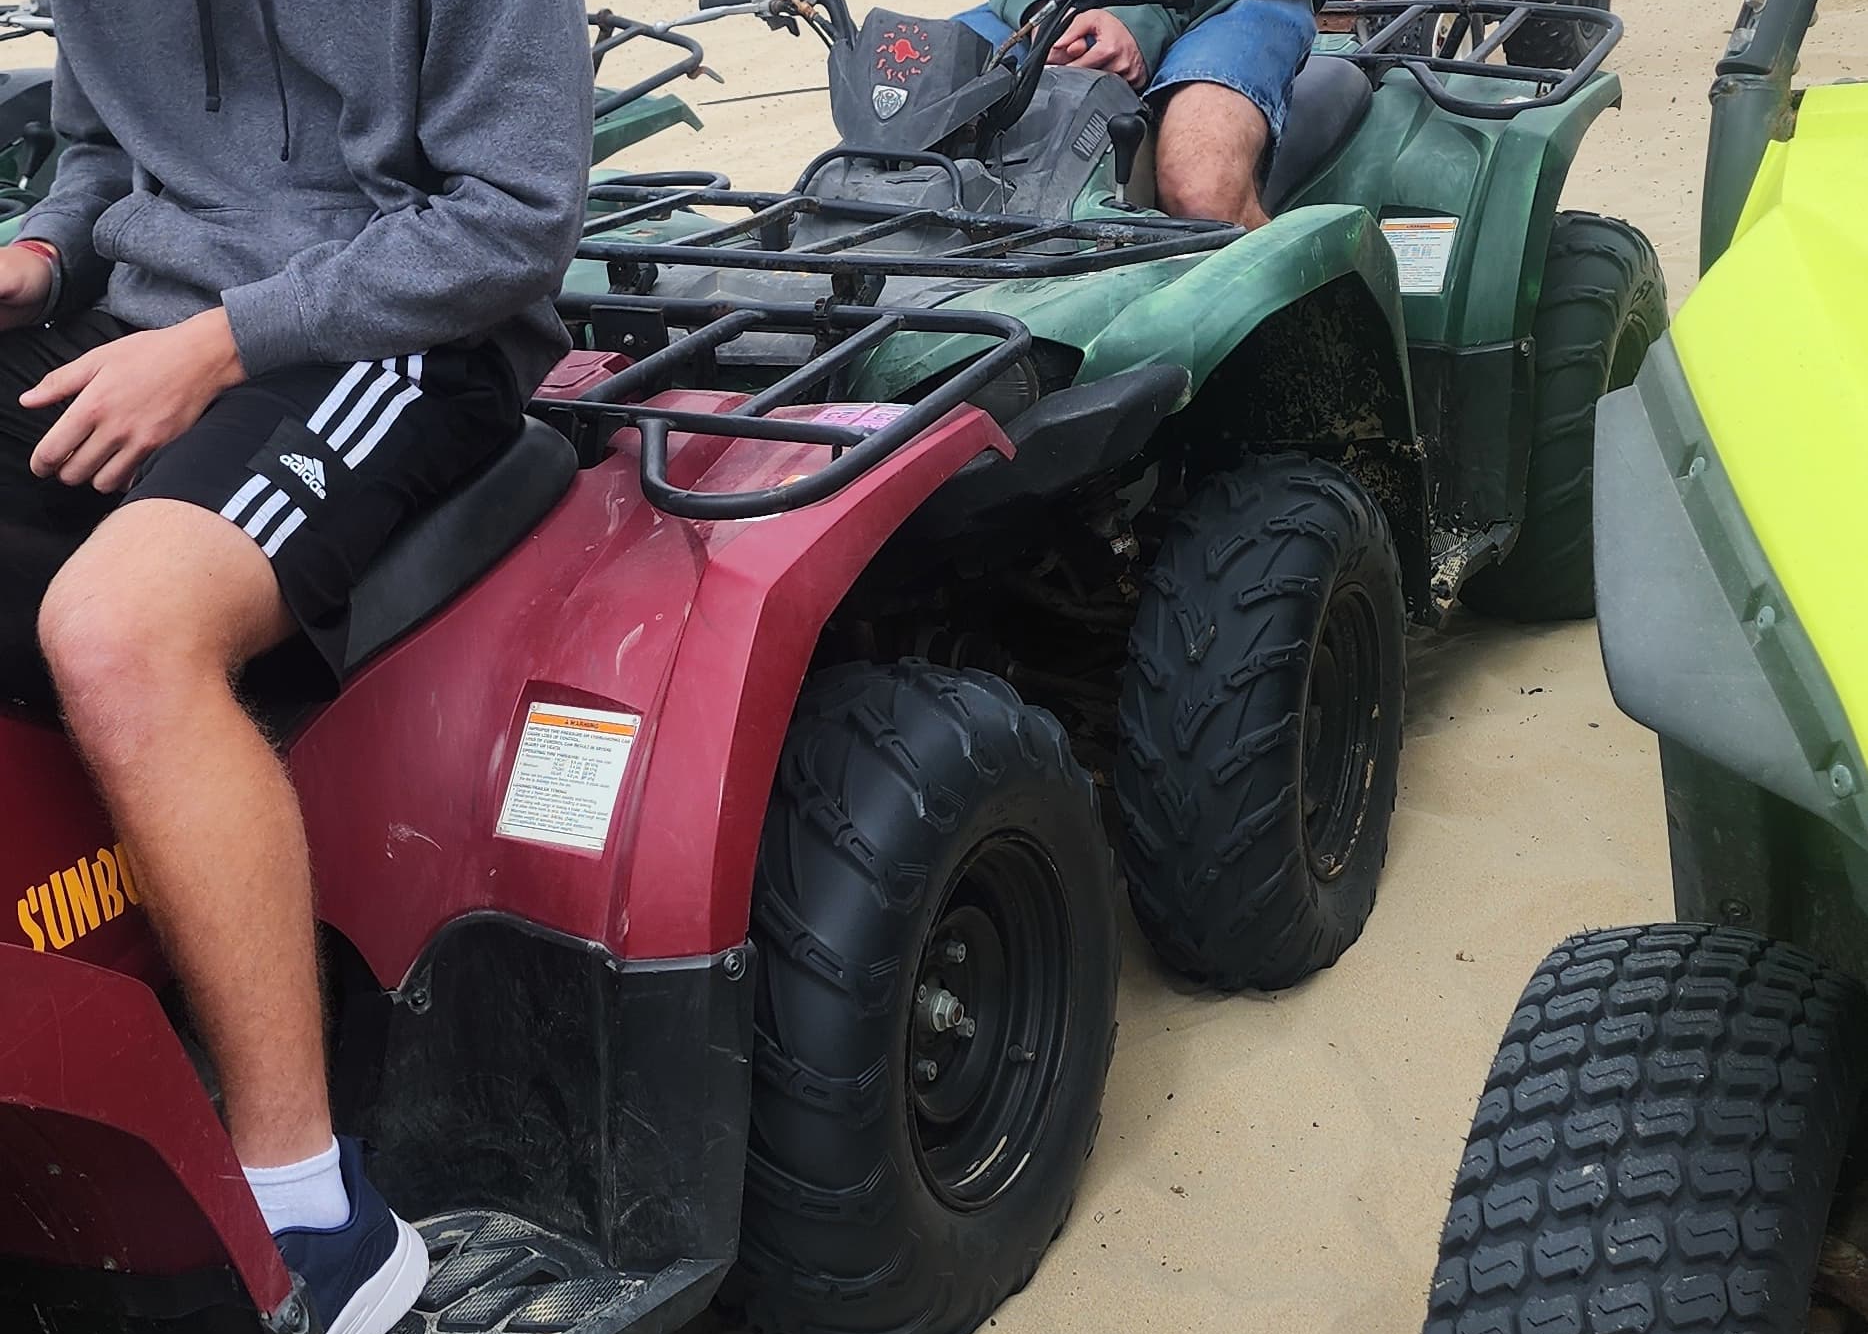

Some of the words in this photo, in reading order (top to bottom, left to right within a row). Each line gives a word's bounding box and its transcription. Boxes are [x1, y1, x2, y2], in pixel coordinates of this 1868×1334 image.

[1073, 113, 1108, 157] YAMAHA
[279, 454, 327, 500] adidas
[17, 841, 142, 953] SUNBU
